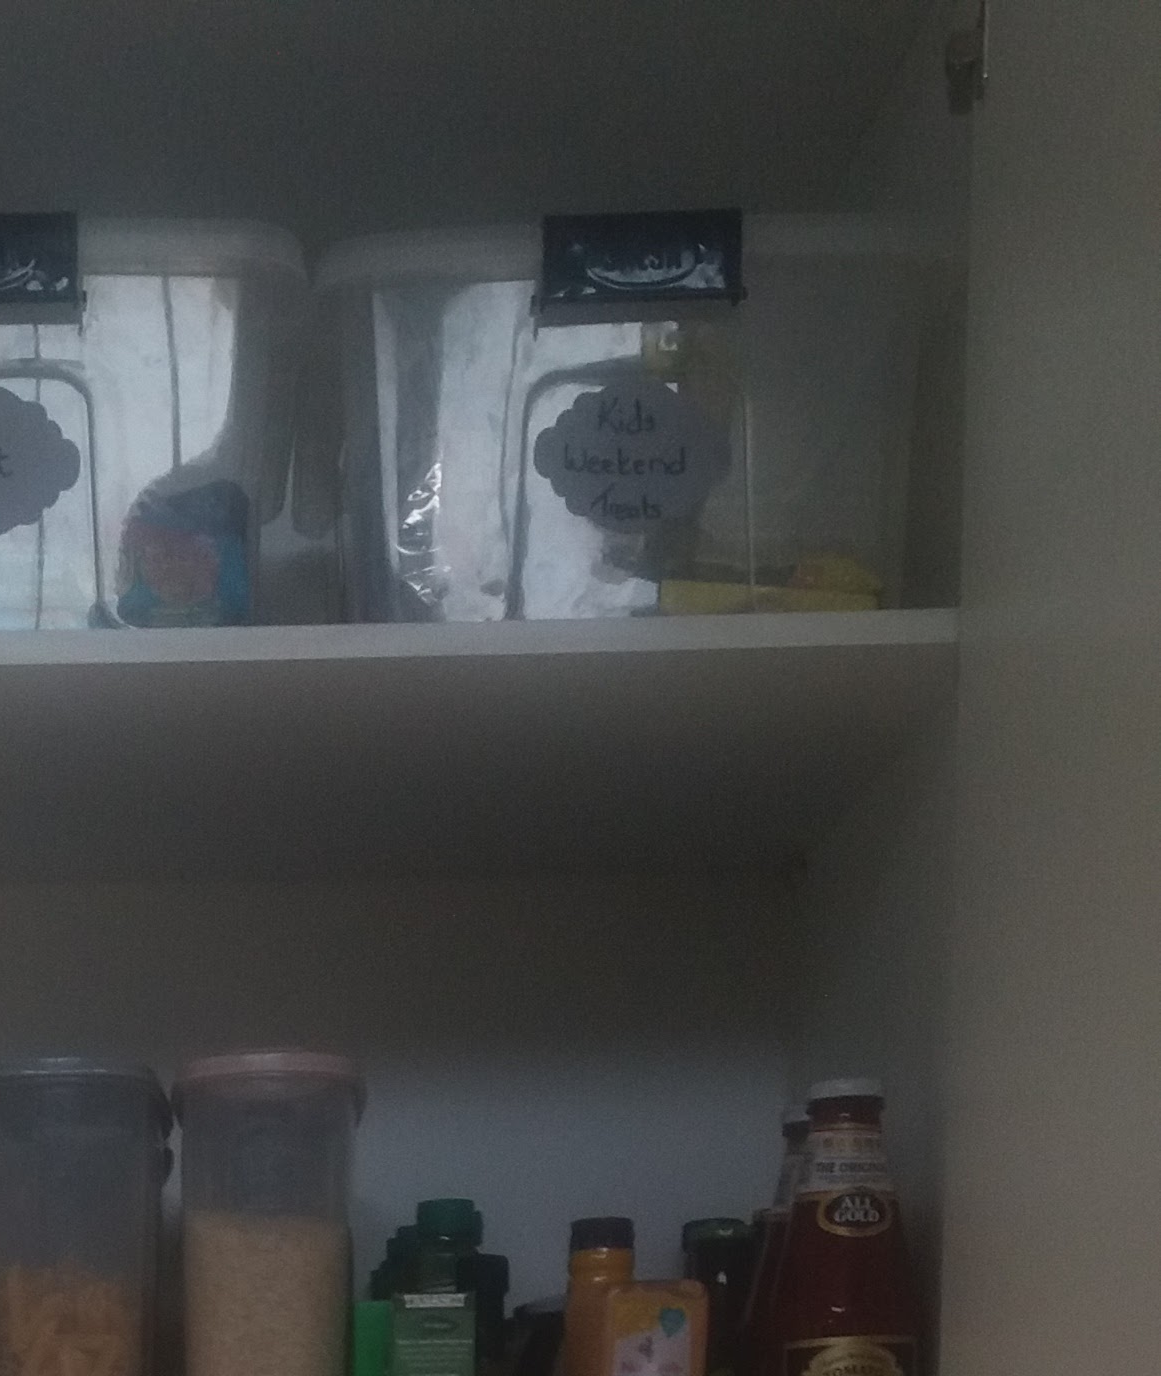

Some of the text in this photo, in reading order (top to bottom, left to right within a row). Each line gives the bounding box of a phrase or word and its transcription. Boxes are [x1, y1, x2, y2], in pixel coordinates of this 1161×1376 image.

[597, 397, 656, 435] Kids
[563, 442, 687, 476] Weekend
[590, 482, 663, 522] Treats
[833, 1209, 881, 1224] GOLD
